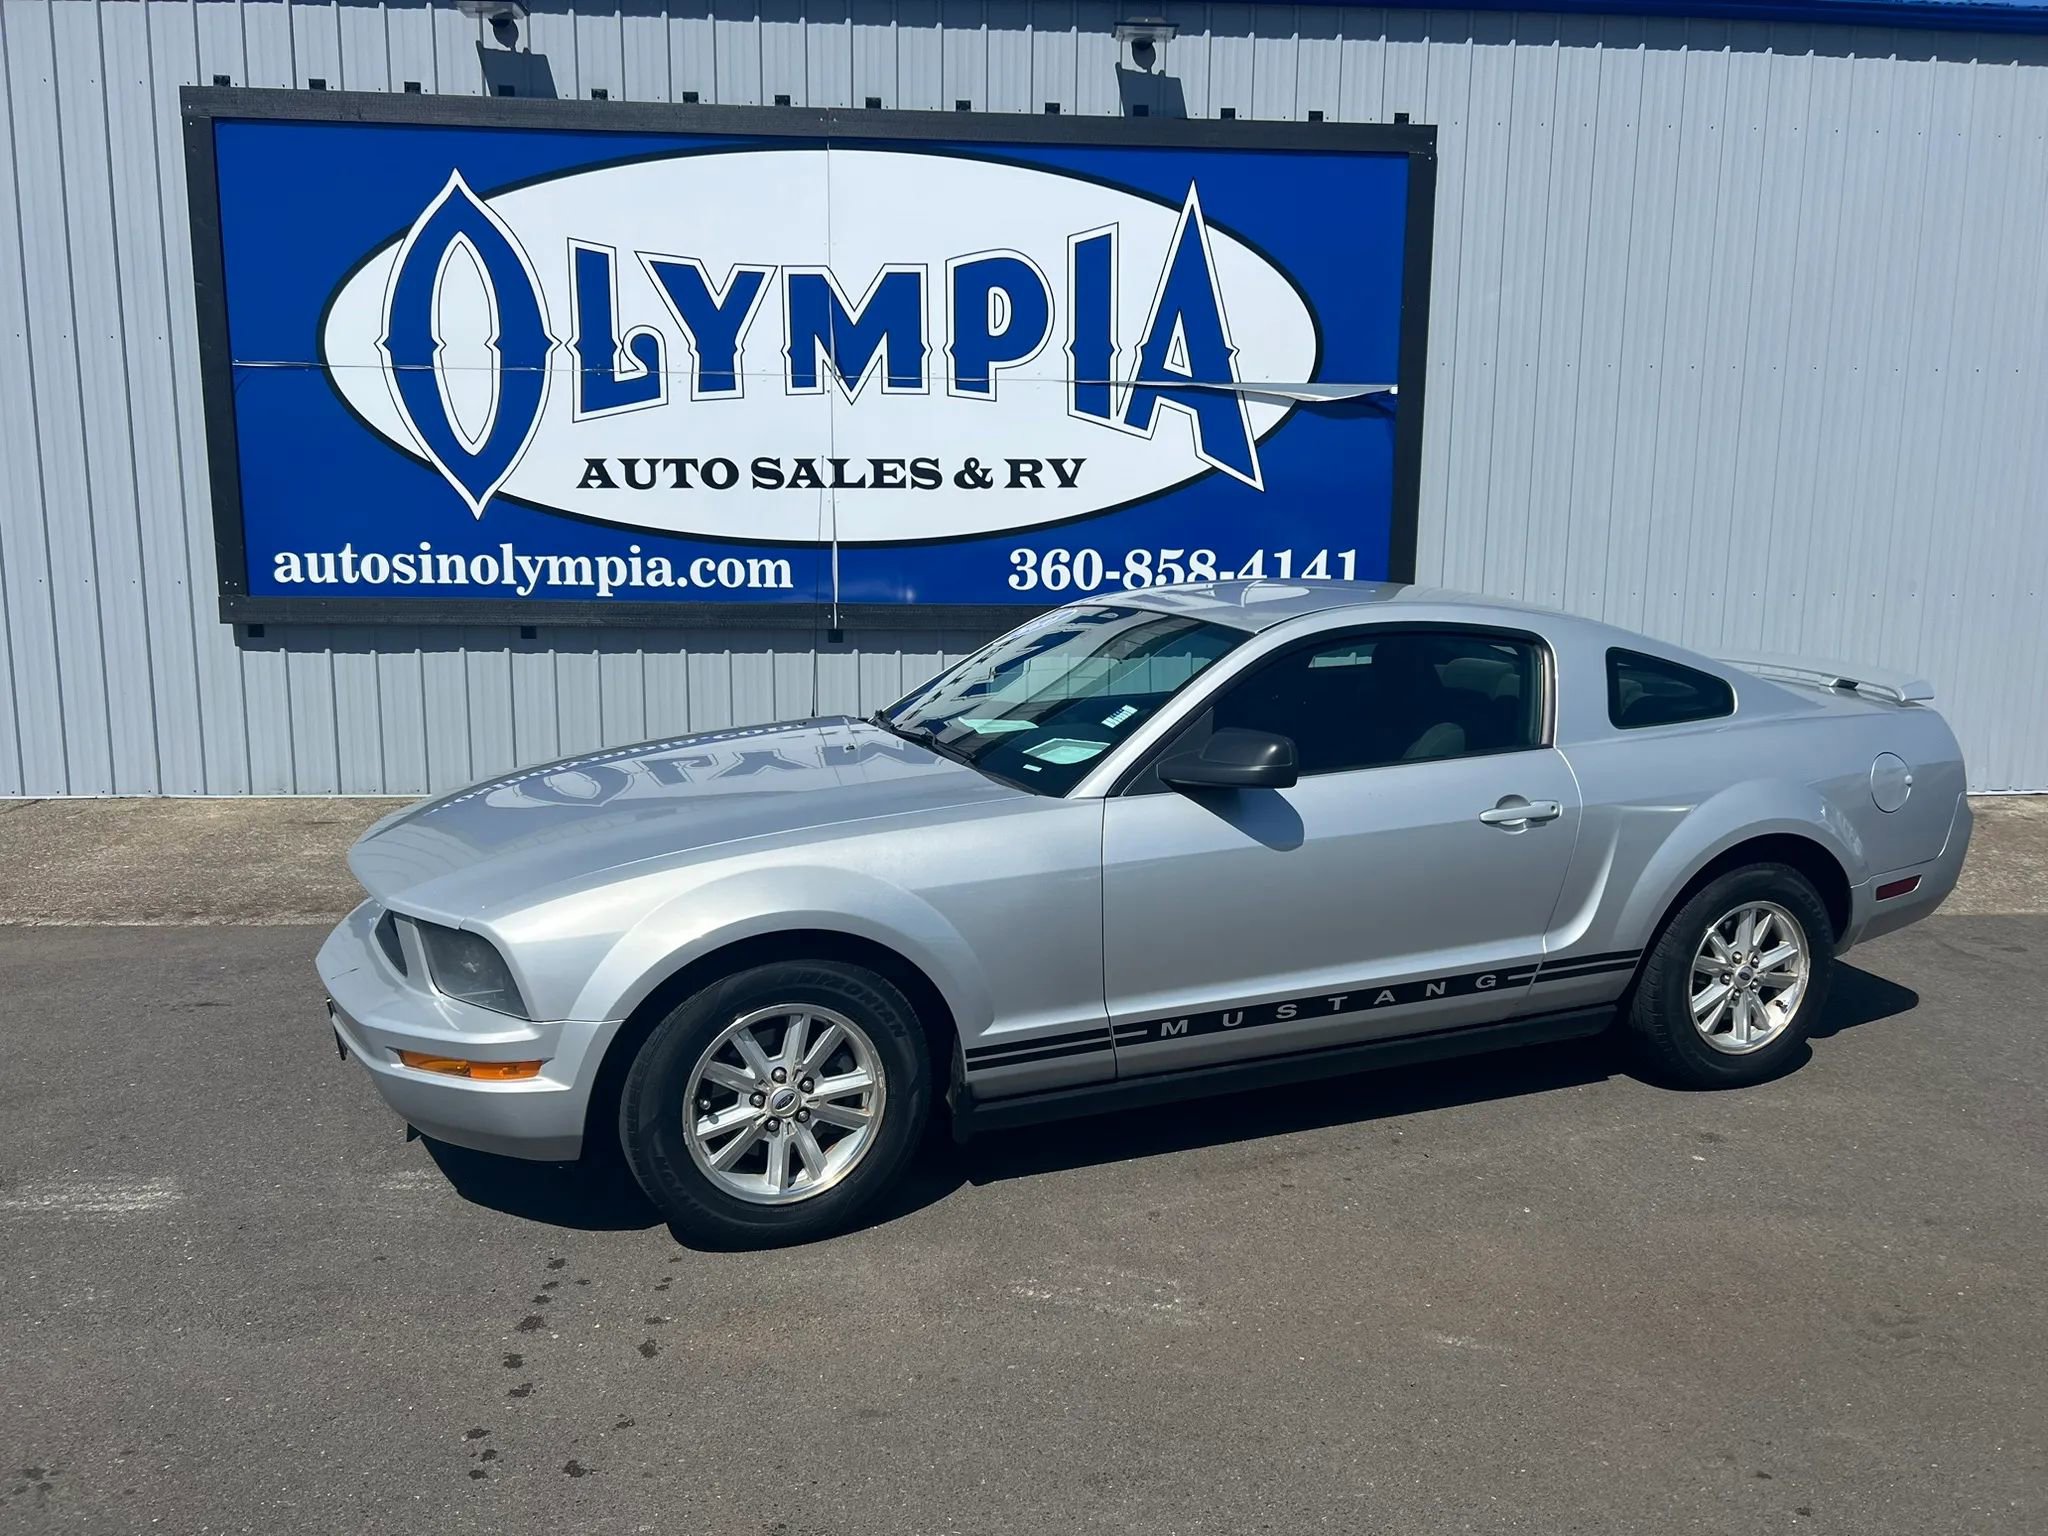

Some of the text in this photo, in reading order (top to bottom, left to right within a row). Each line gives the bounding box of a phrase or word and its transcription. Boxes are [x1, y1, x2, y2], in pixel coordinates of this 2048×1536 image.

[374, 167, 1265, 521] OLYMPIA
[576, 456, 1088, 490] AUTO SALES & RV
[272, 541, 794, 597] autosinolympia.com
[1008, 548, 1358, 591] 360-858-4141
[1160, 974, 1497, 1037] MUSTANG
